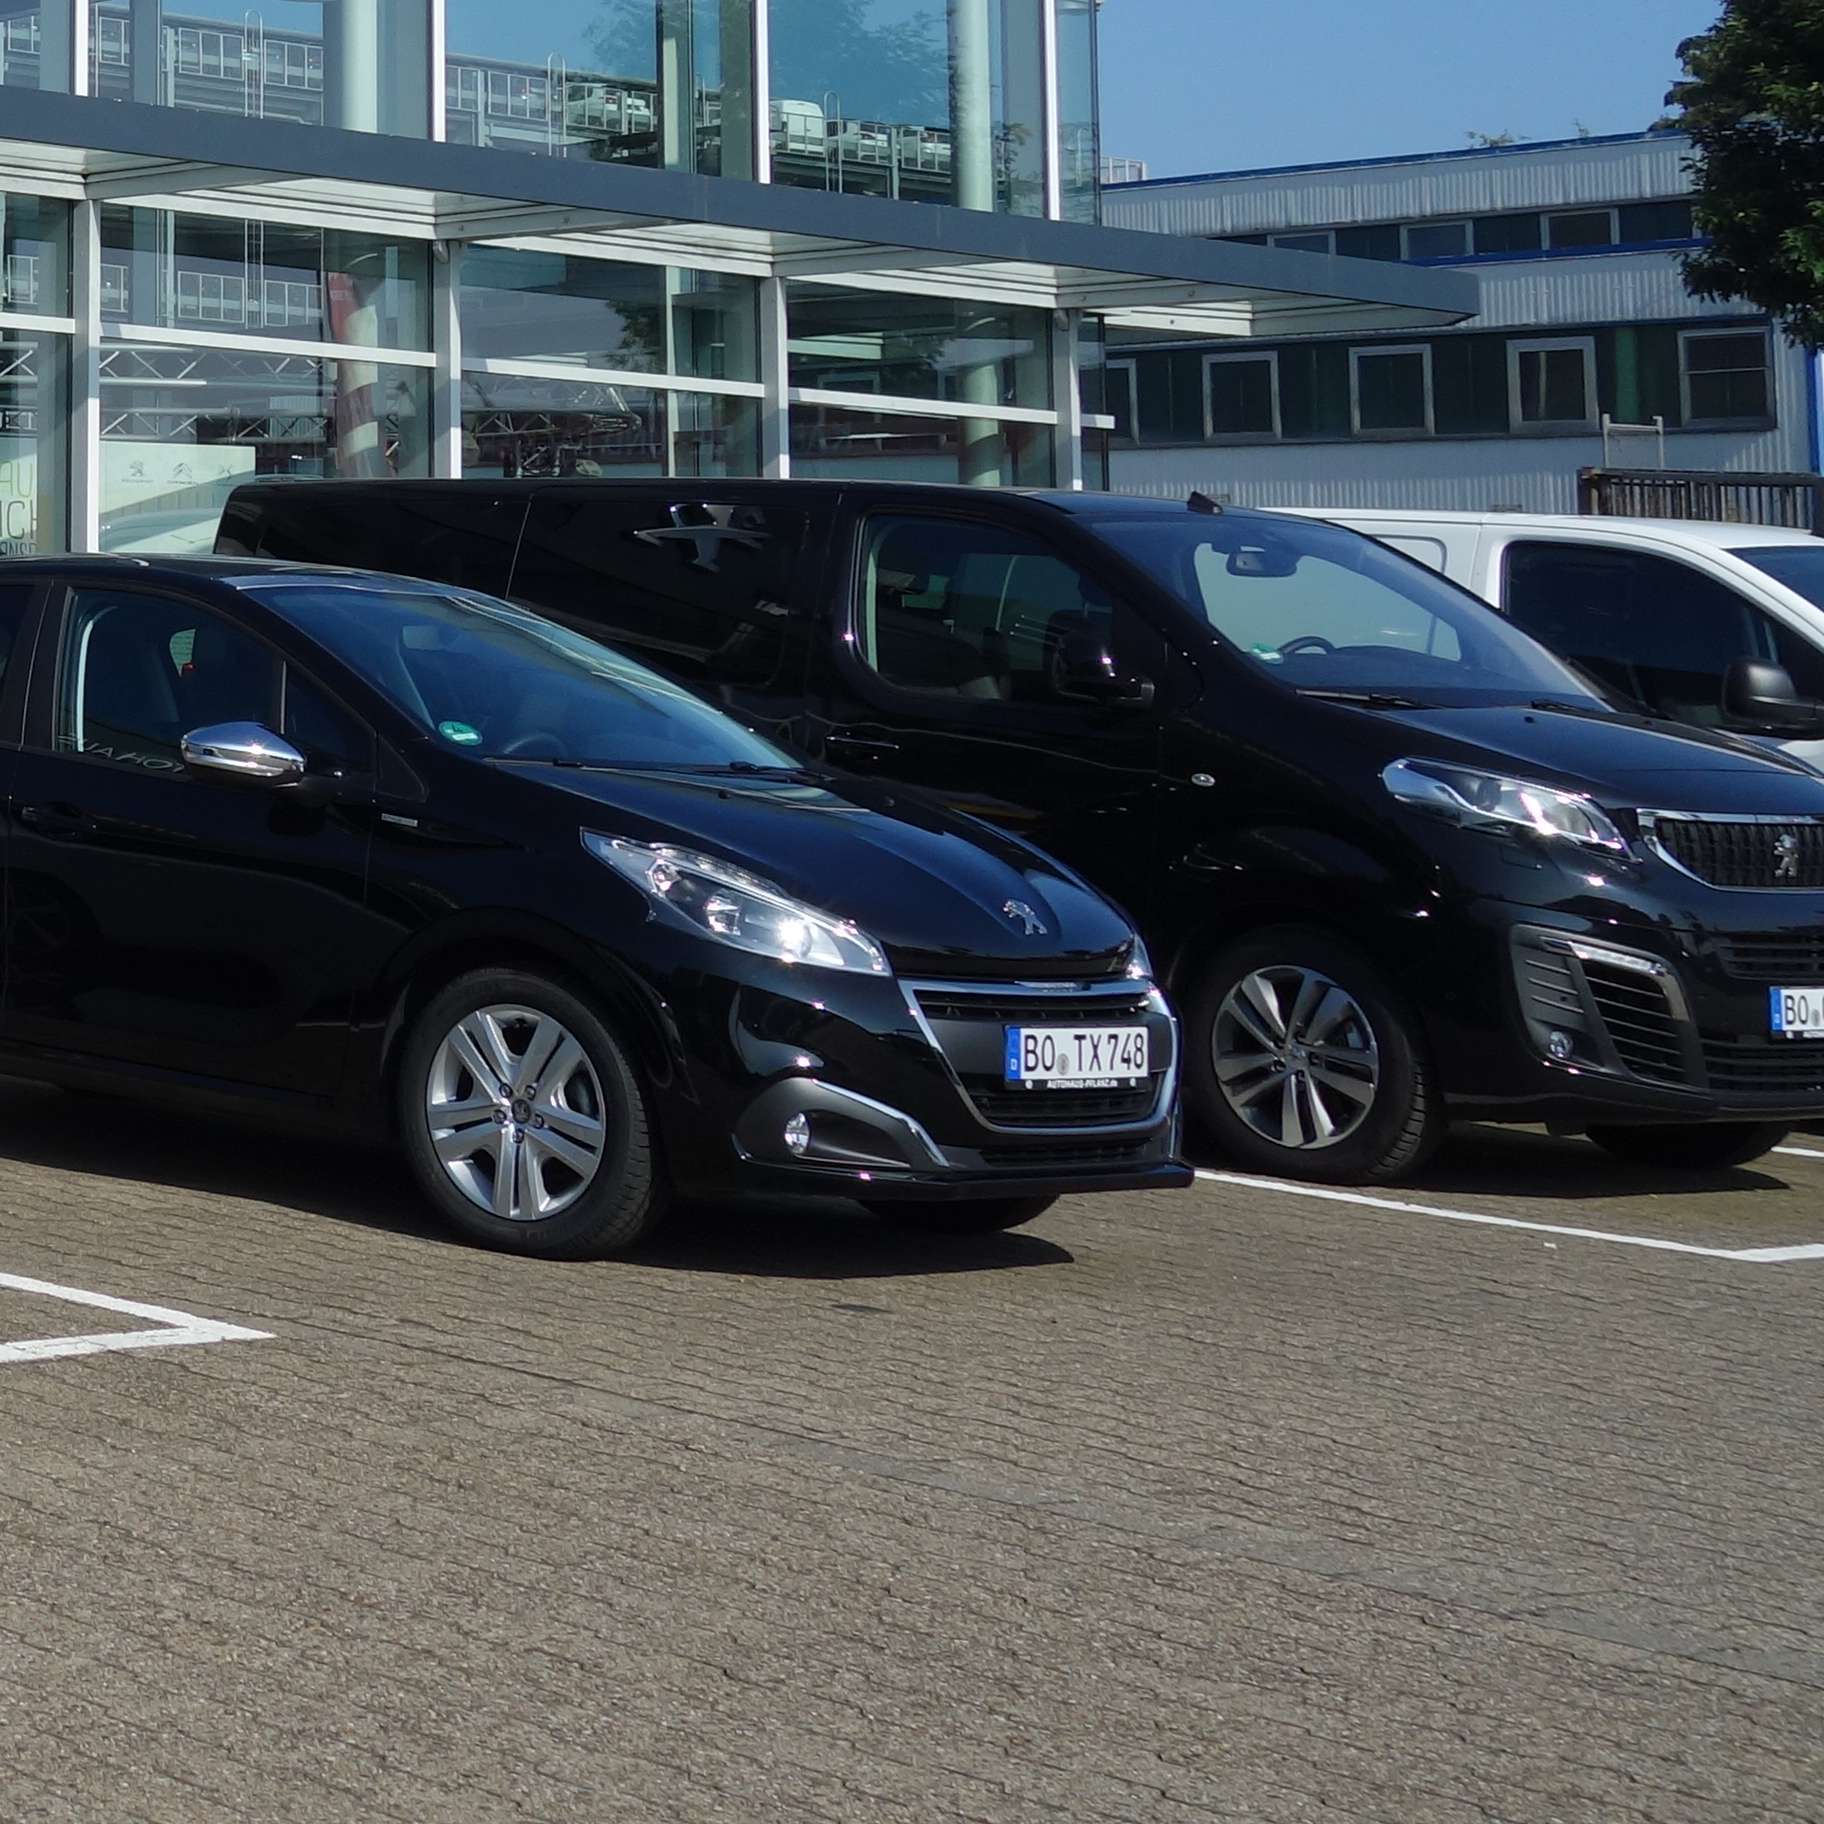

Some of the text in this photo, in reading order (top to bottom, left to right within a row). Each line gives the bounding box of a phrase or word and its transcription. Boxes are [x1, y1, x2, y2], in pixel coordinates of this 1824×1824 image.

[1783, 994, 1809, 1025] BO
[1024, 1032, 1145, 1072] BO TX 748
